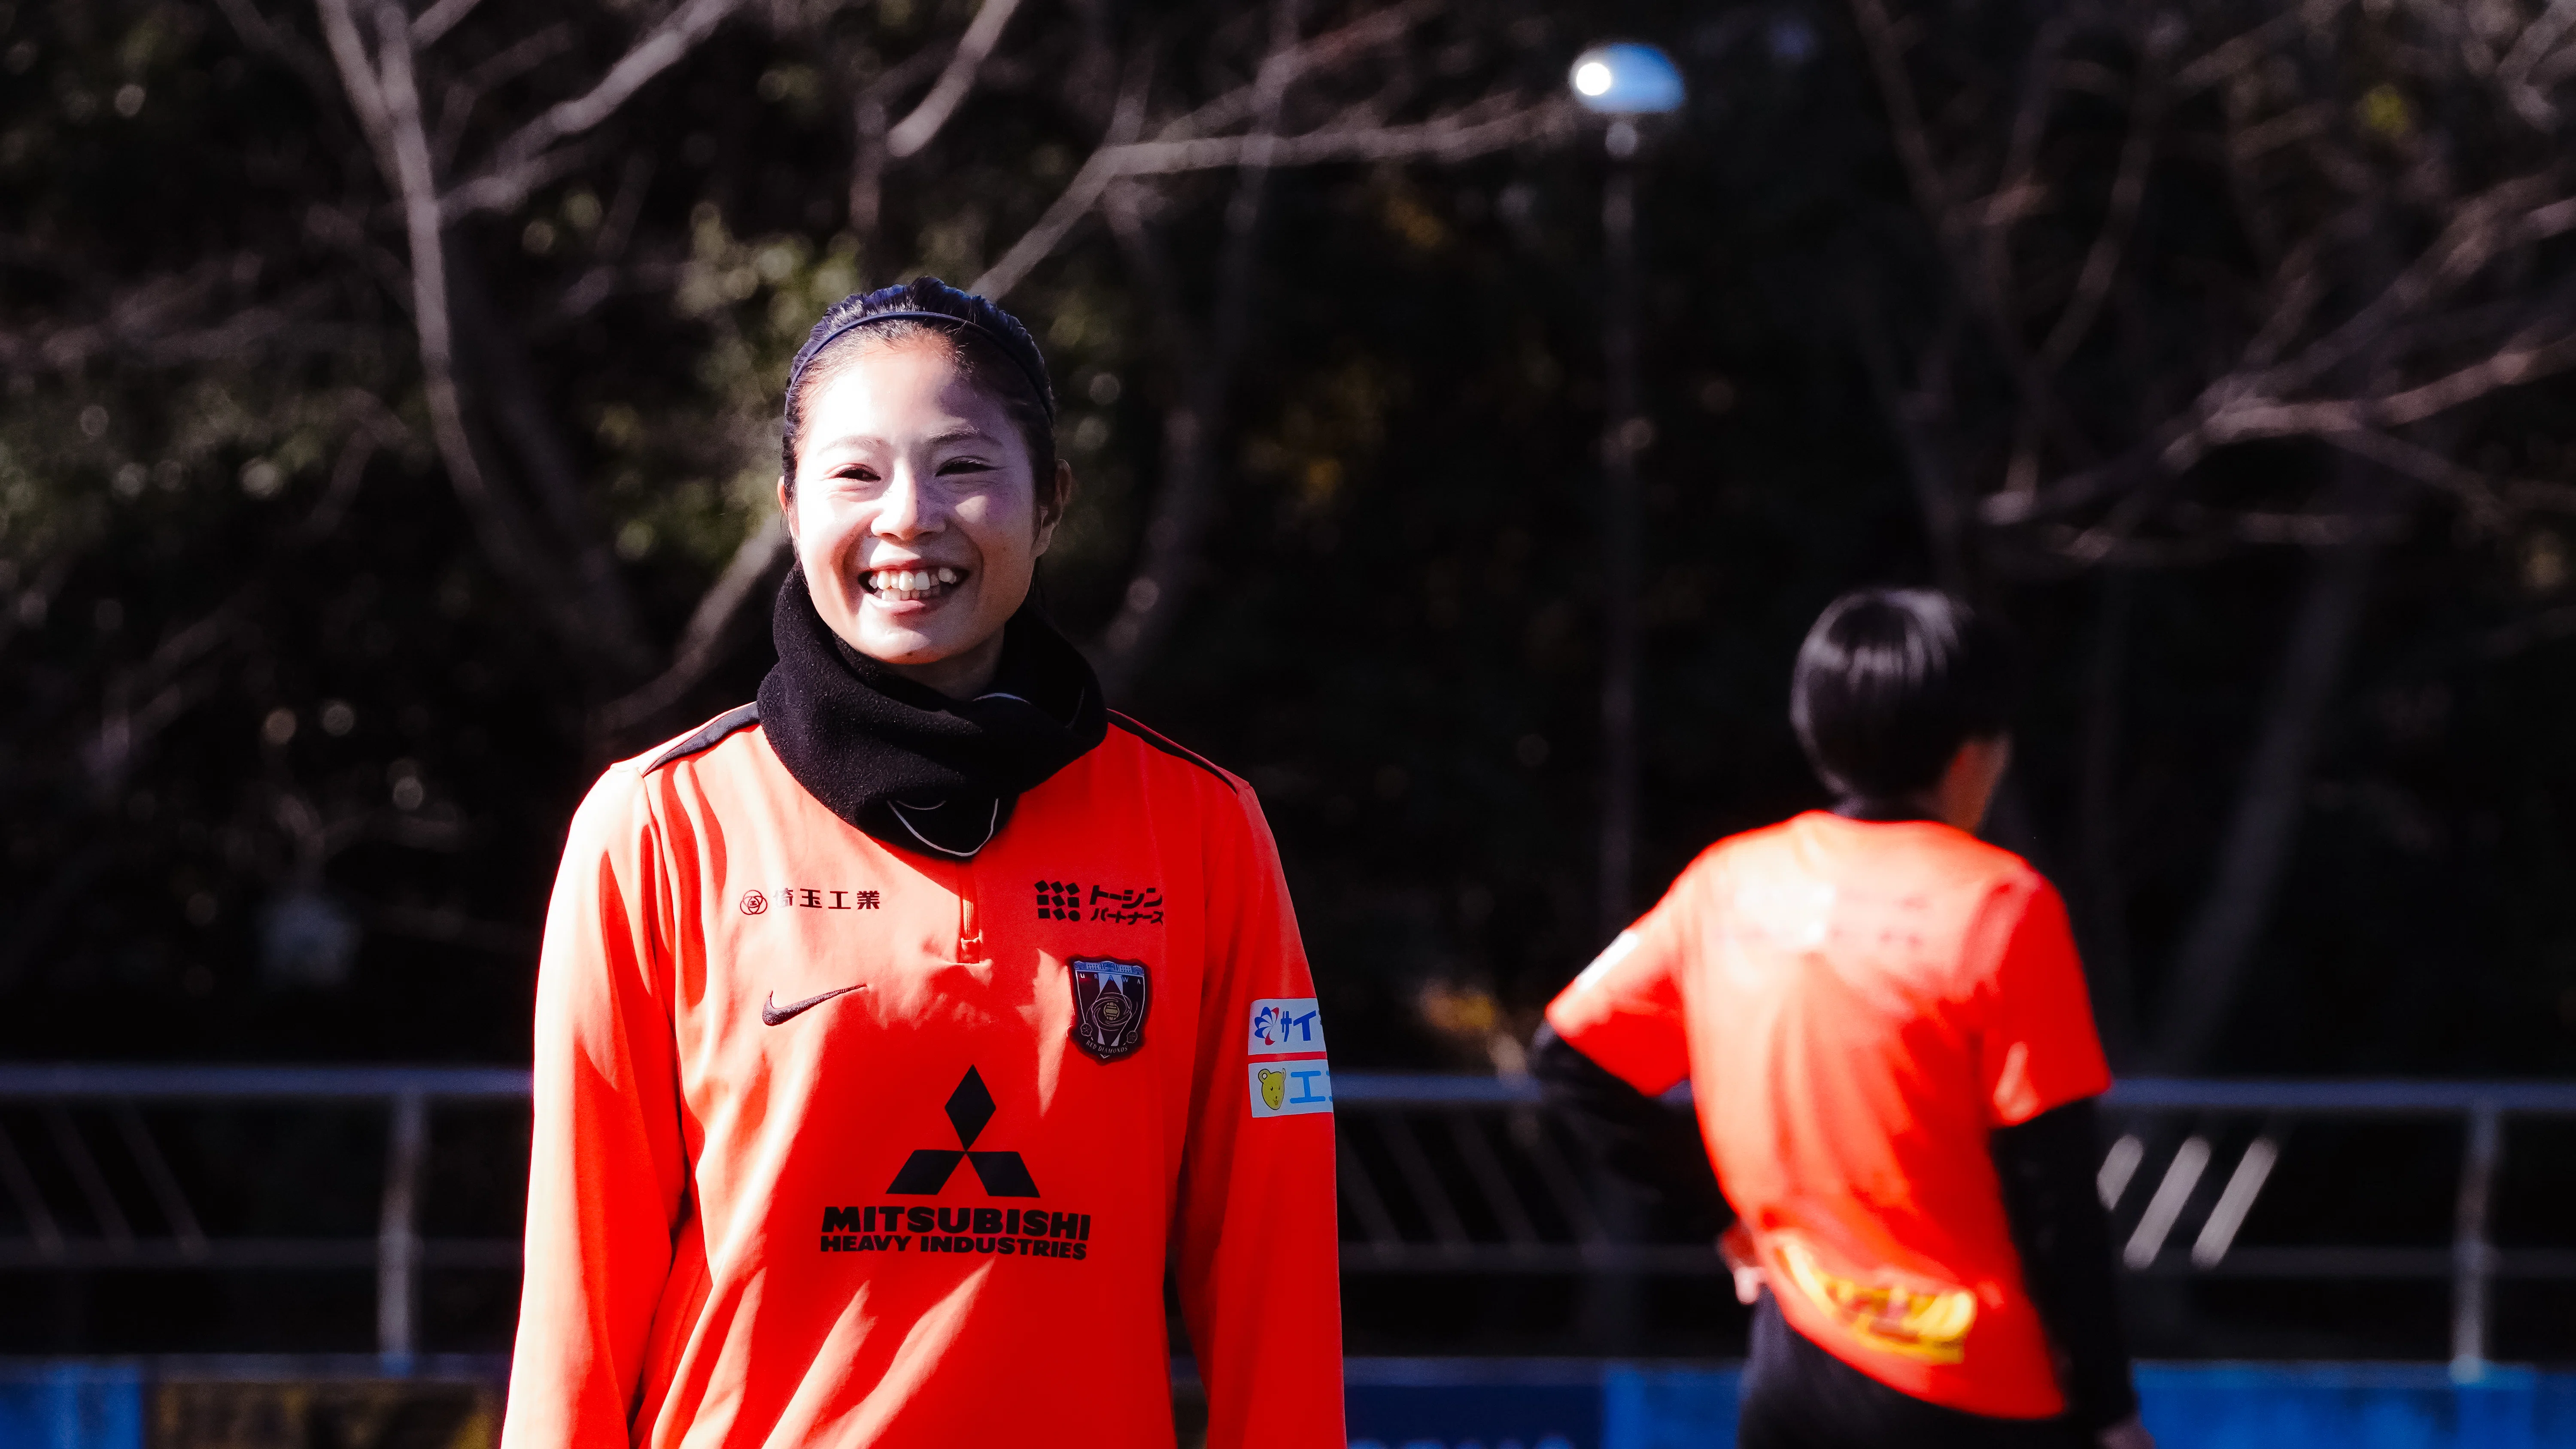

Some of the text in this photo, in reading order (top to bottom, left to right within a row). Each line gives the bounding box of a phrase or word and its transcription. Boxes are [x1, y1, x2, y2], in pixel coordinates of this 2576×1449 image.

[773, 888, 879, 909] 埼玉工業
[1089, 885, 1163, 909] トーシン
[1080, 973, 1141, 984] URAWA
[1280, 1009, 1322, 1042] サイ
[1086, 1040, 1097, 1049] RED
[821, 1206, 1091, 1240] MITSUBISHI
[820, 1235, 1087, 1260] HEAVY INDUSTRIES
